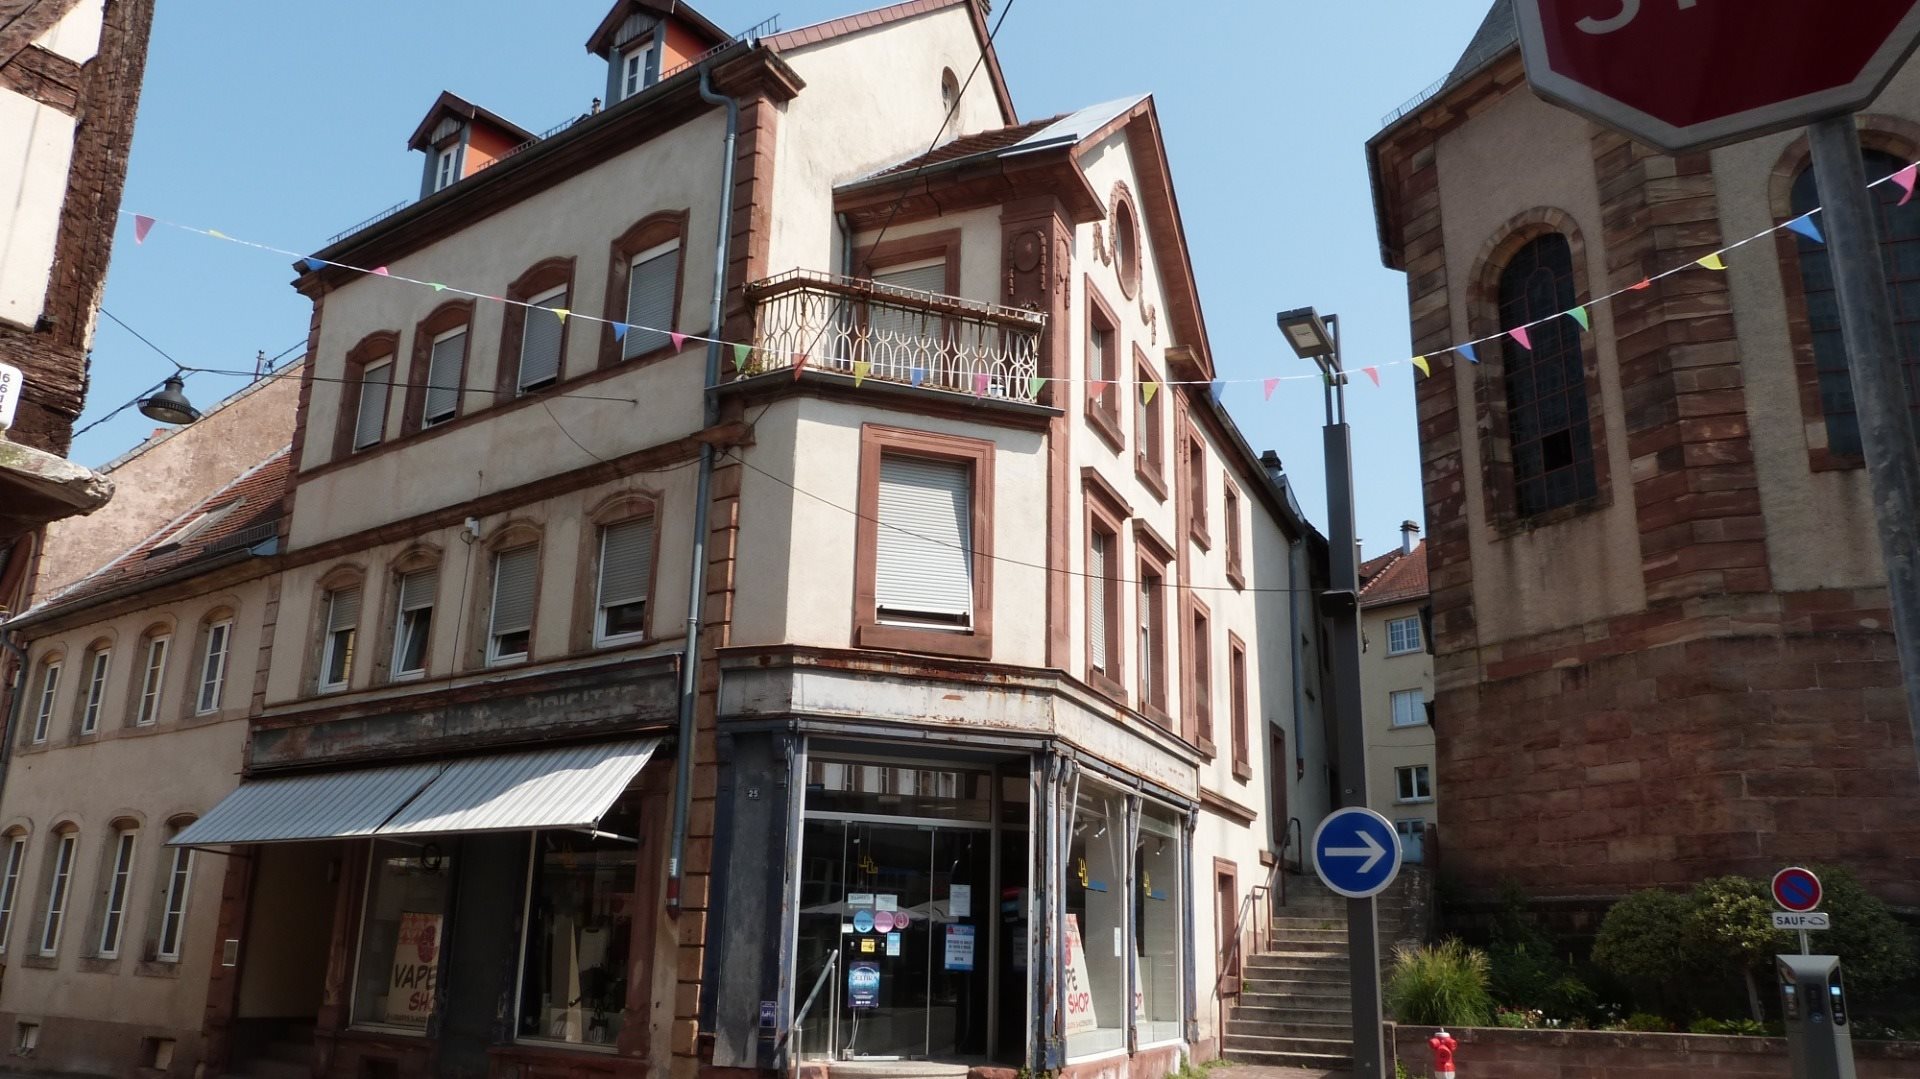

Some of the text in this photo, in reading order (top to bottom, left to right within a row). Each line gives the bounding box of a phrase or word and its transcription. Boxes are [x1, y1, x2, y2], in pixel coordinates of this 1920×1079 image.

[748, 789, 759, 798] 25
[1775, 915, 1806, 926] SAUF
[394, 965, 437, 990] VAPE
[1067, 993, 1090, 1014] SHOP
